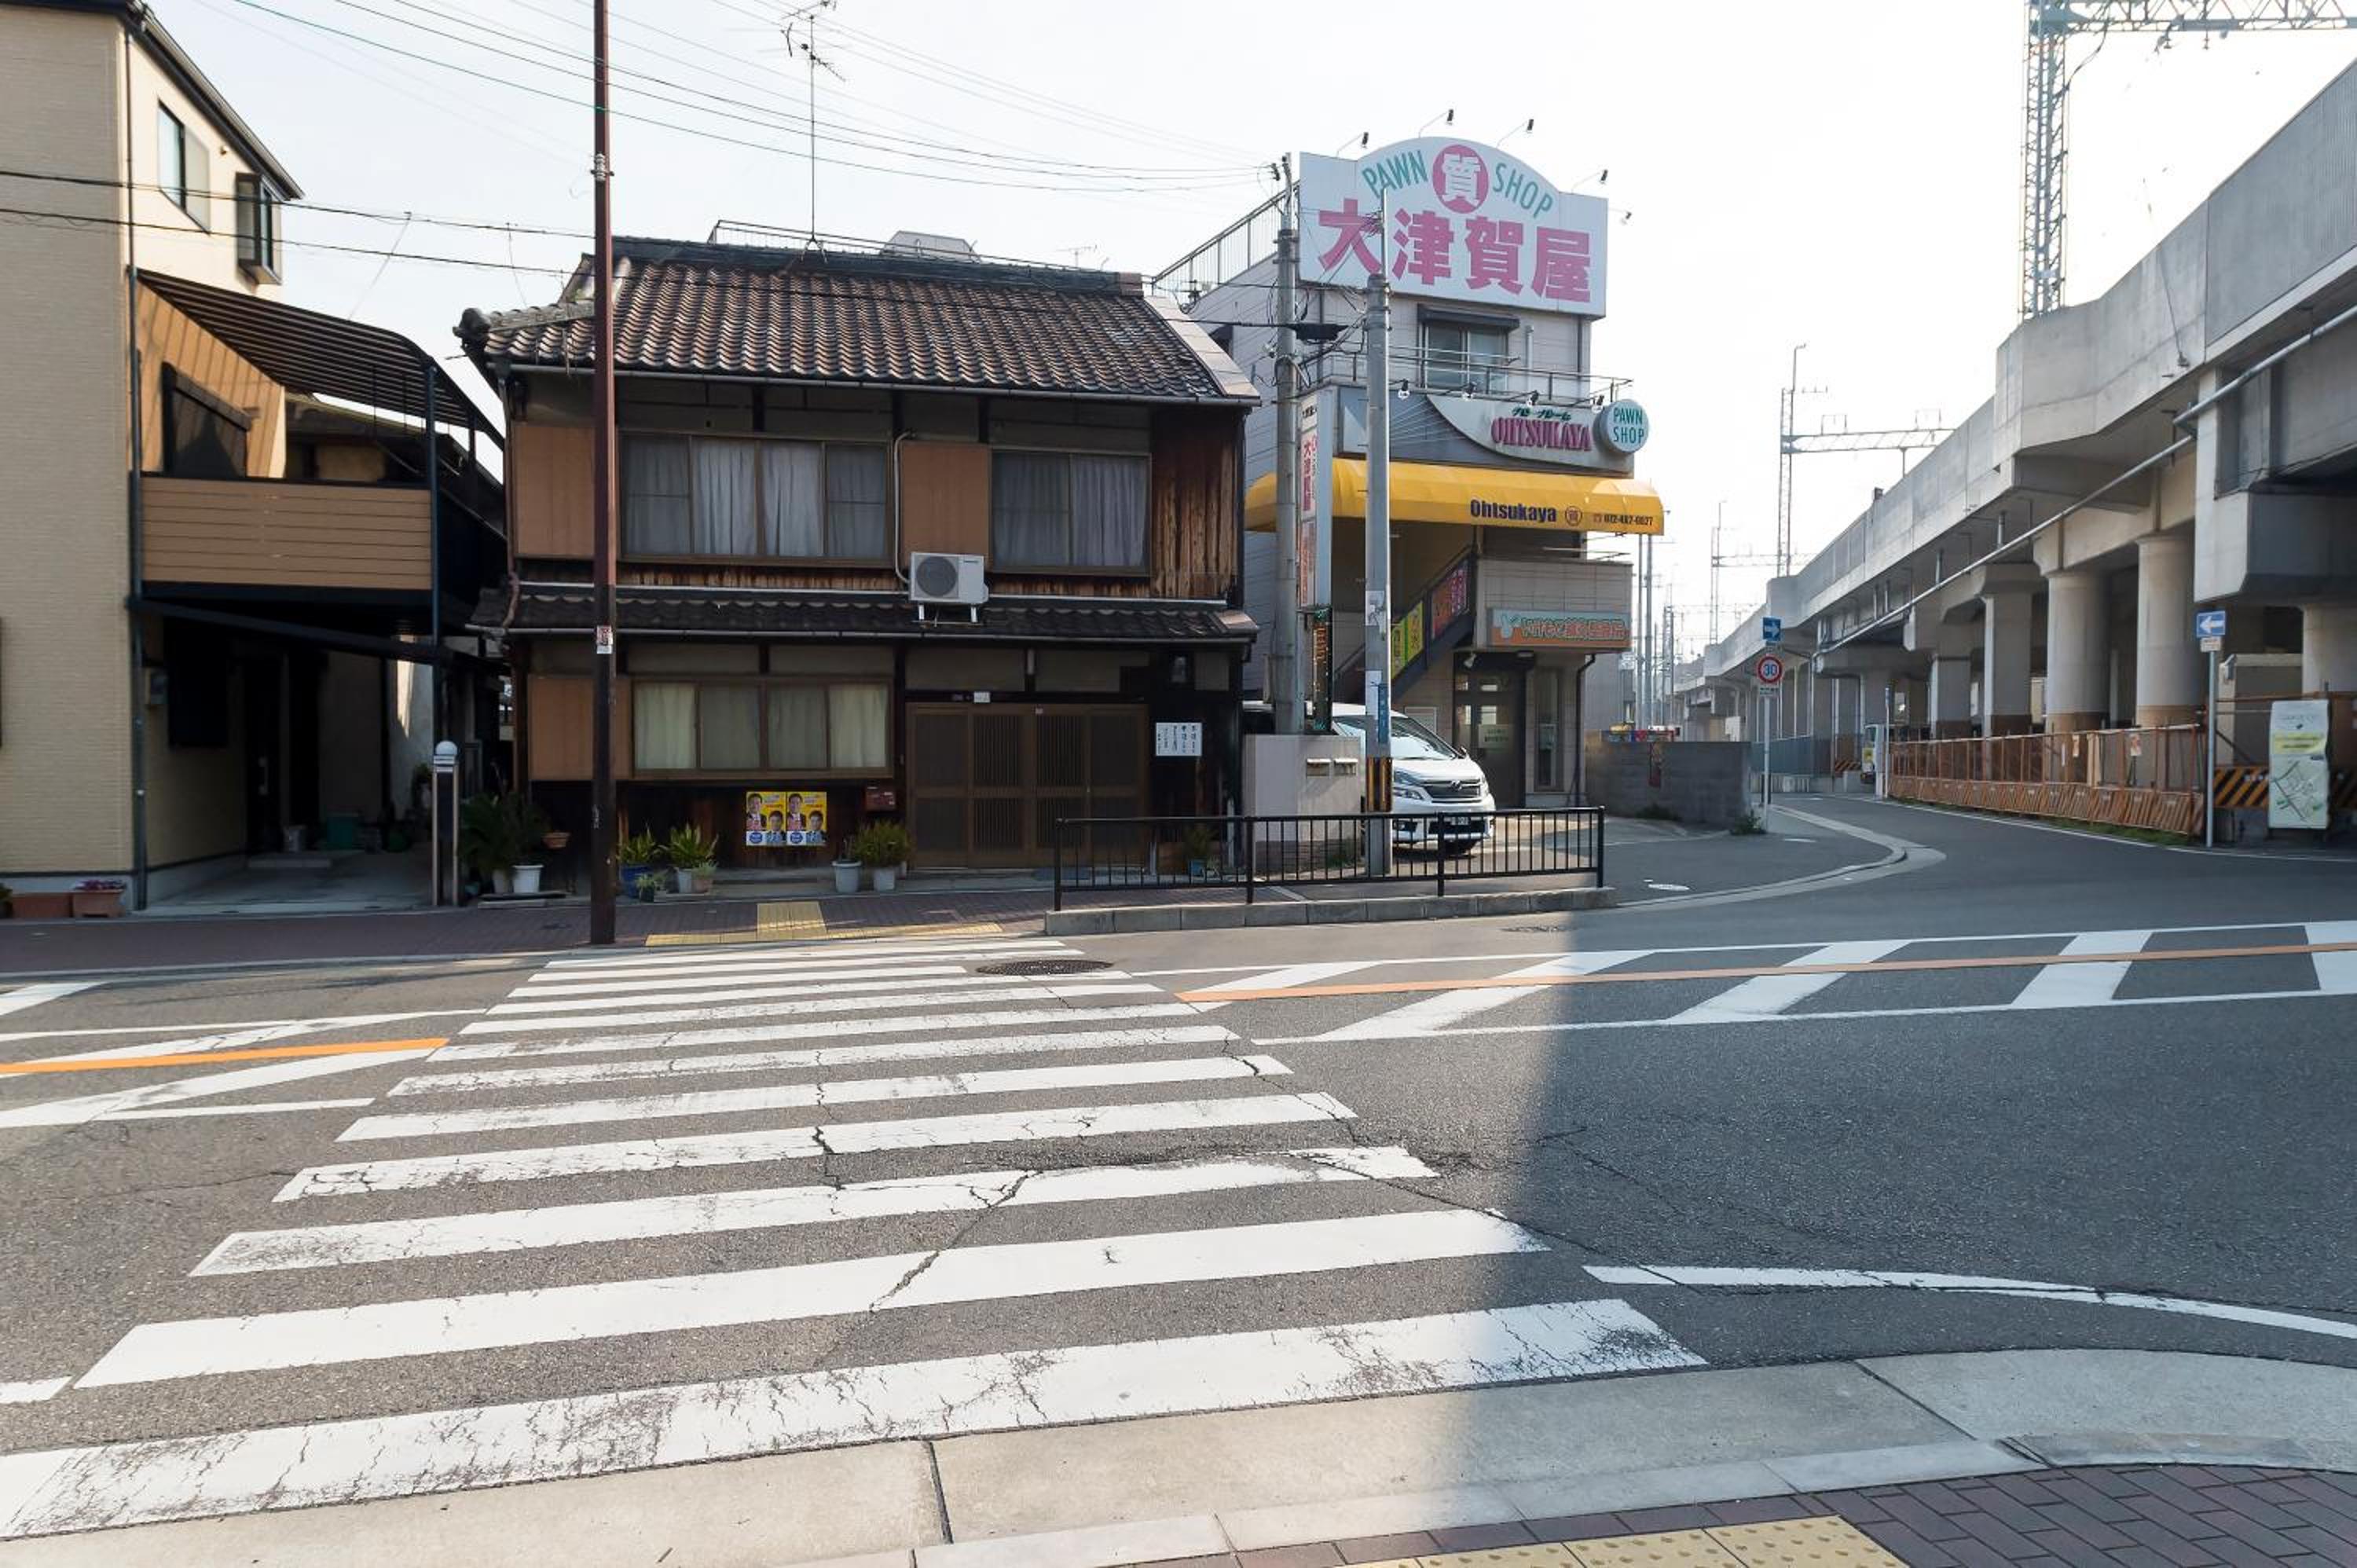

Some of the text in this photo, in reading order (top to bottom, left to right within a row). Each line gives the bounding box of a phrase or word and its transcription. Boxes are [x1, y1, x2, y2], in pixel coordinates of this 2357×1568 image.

[1362, 150, 1553, 218] PAWN SHOP
[1442, 153, 1481, 206] 質
[1318, 198, 1591, 303] 大津賀屋
[1614, 408, 1643, 424] PAWN
[1491, 417, 1591, 451] OHTSUKAYA
[1613, 427, 1644, 443] SHOP
[1471, 500, 1556, 522] Ohtsukaya
